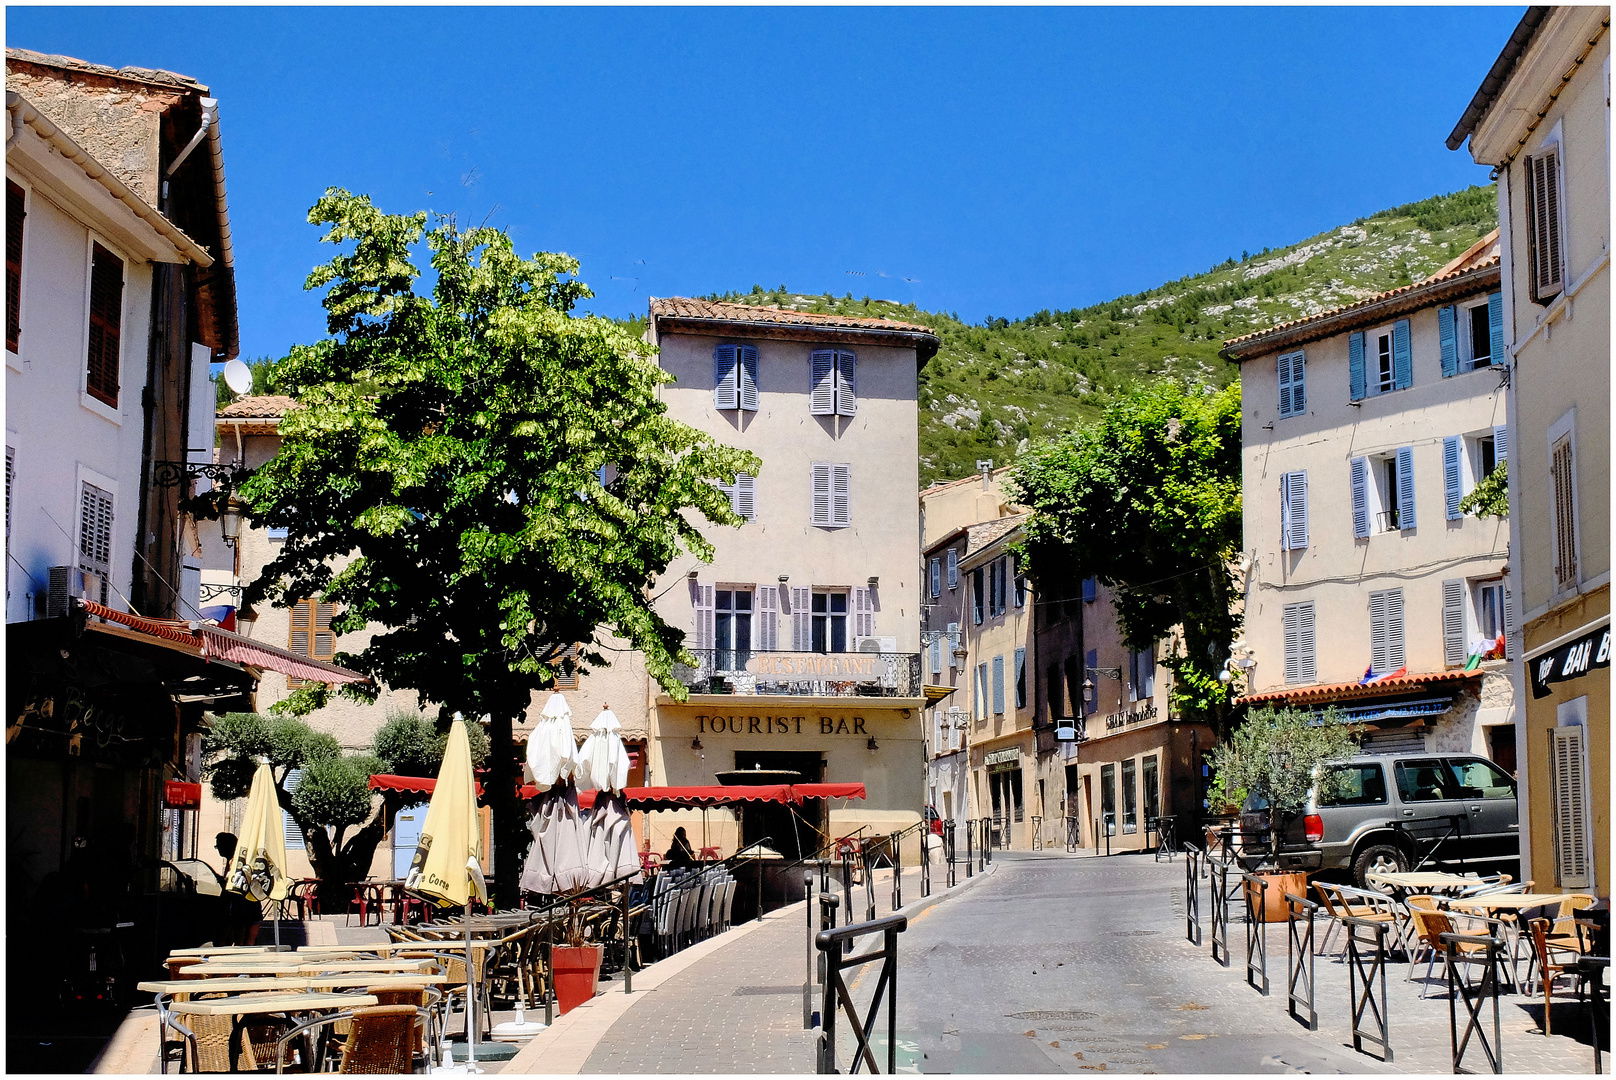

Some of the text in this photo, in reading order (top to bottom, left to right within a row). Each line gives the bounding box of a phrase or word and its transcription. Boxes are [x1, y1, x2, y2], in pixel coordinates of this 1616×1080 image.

[1562, 639, 1593, 676] BAR
[1596, 631, 1610, 663] B
[757, 656, 876, 675] RESTAURANT
[695, 715, 868, 734] TOURIST BAR
[428, 873, 449, 890] Corse
